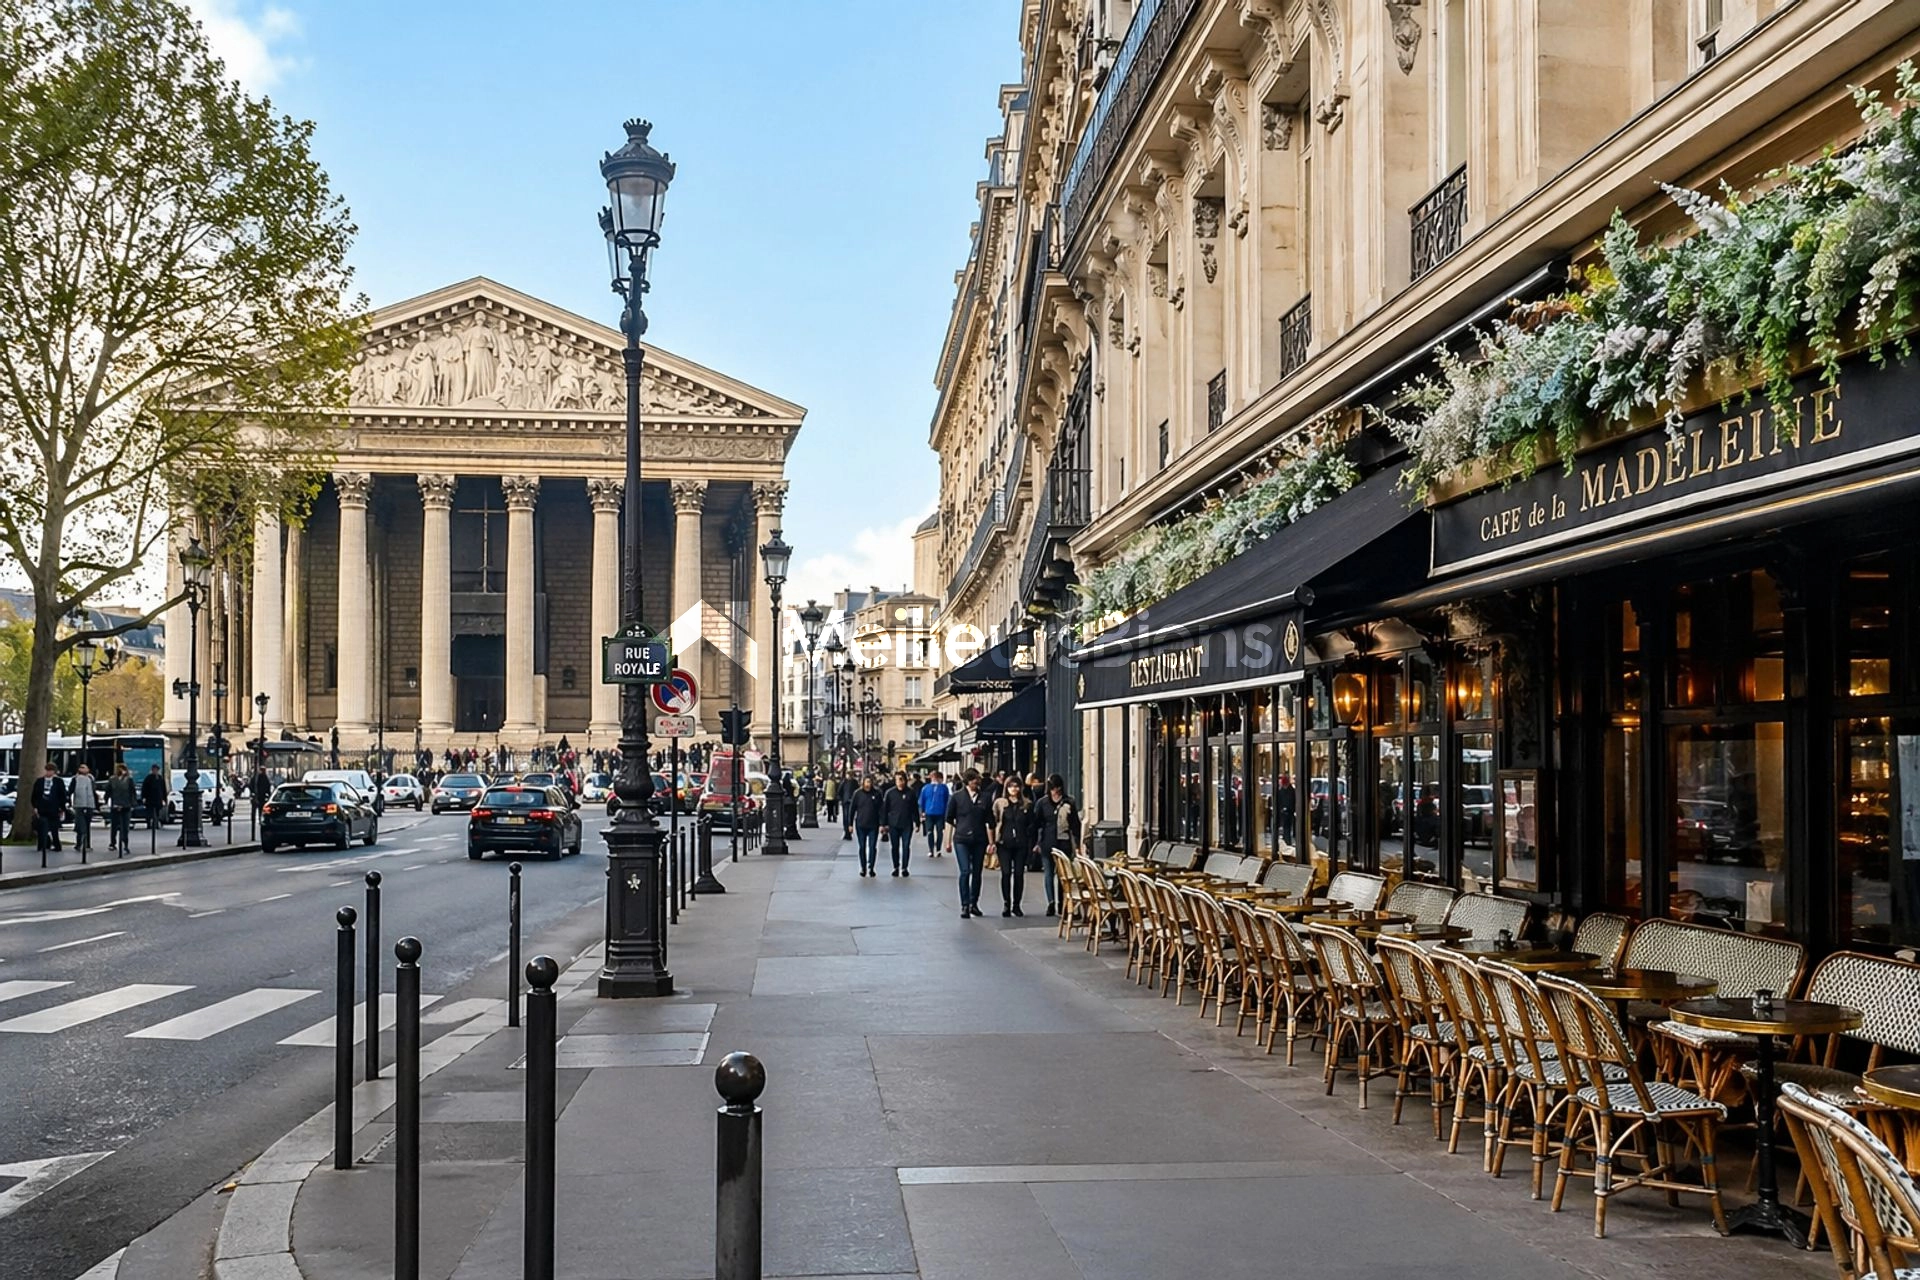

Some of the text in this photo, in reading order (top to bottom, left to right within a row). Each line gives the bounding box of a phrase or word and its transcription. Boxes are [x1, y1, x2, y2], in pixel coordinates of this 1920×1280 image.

[1481, 383, 1842, 541] CAFE de la MADELEINE
[625, 647, 651, 659] RUE
[1130, 645, 1204, 688] RESTAURANT
[614, 662, 661, 675] ROYALE
